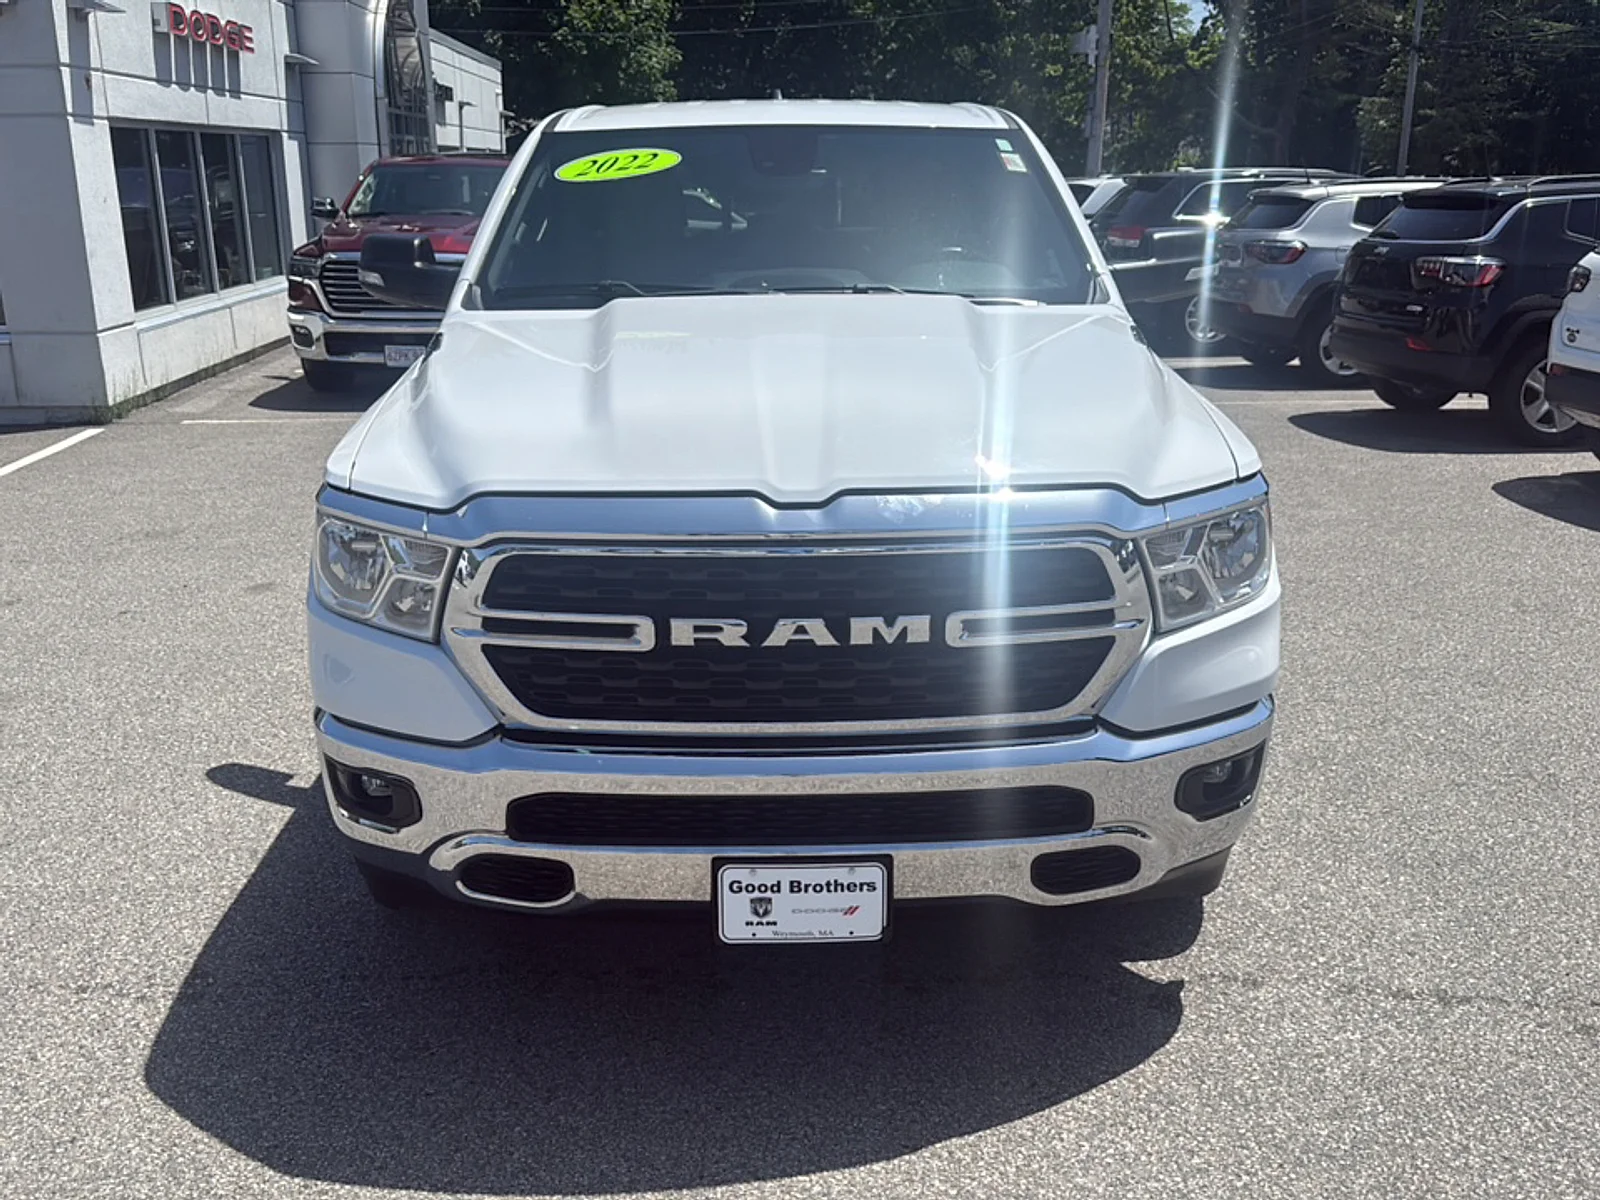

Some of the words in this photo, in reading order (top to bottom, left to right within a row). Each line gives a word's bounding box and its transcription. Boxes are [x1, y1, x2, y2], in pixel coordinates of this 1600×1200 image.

[169, 2, 255, 53] DODGE
[573, 153, 659, 177] 2022
[669, 615, 931, 647] RAM
[728, 879, 782, 894] Good
[788, 878, 877, 893] Brothers
